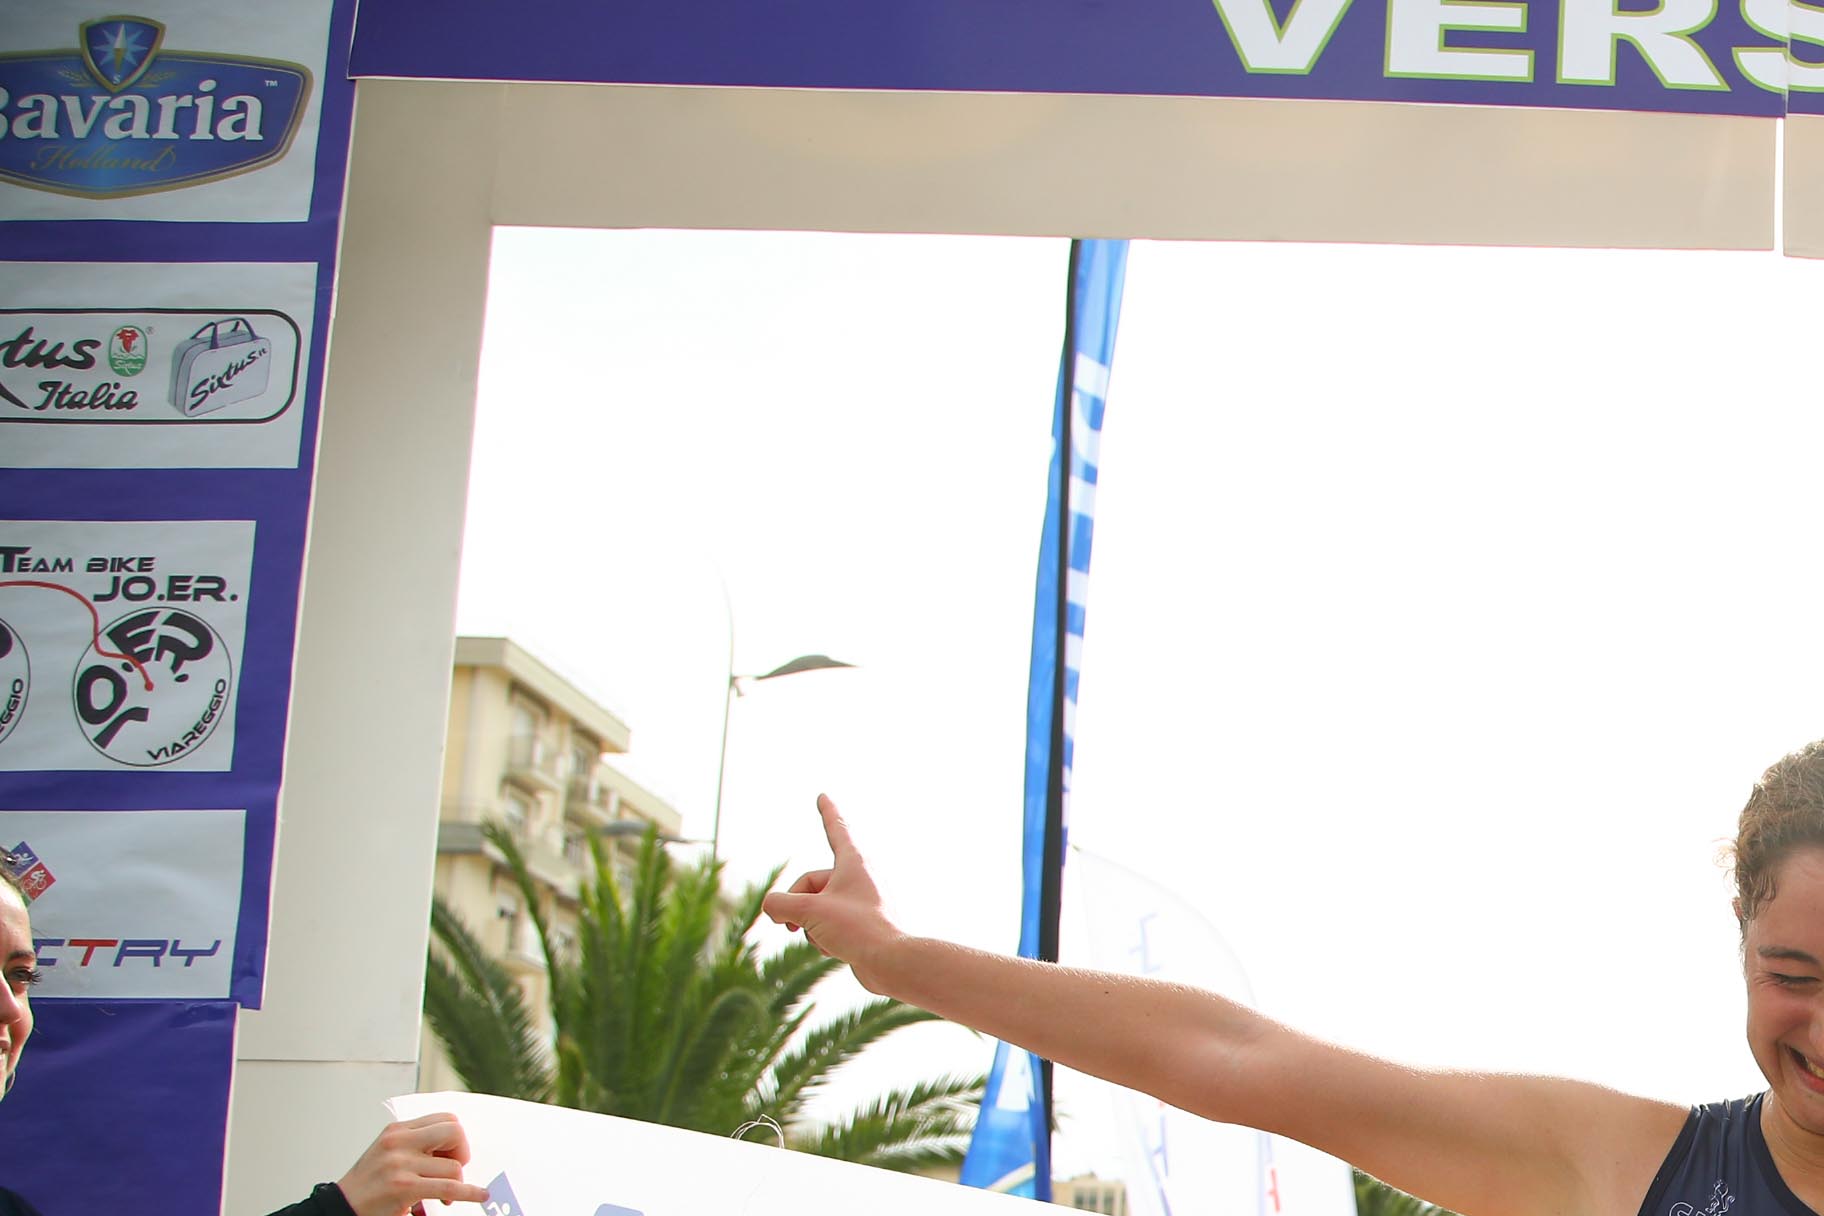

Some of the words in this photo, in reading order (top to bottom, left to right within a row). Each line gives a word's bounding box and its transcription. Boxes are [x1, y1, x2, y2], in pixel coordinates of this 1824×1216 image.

[0, 79, 264, 141] avaria
[0, 326, 102, 370] tus
[33, 380, 139, 411] Italia
[86, 556, 156, 573] BIKE
[93, 575, 239, 602] JO.ER.
[146, 678, 227, 761] VIAREGGIO
